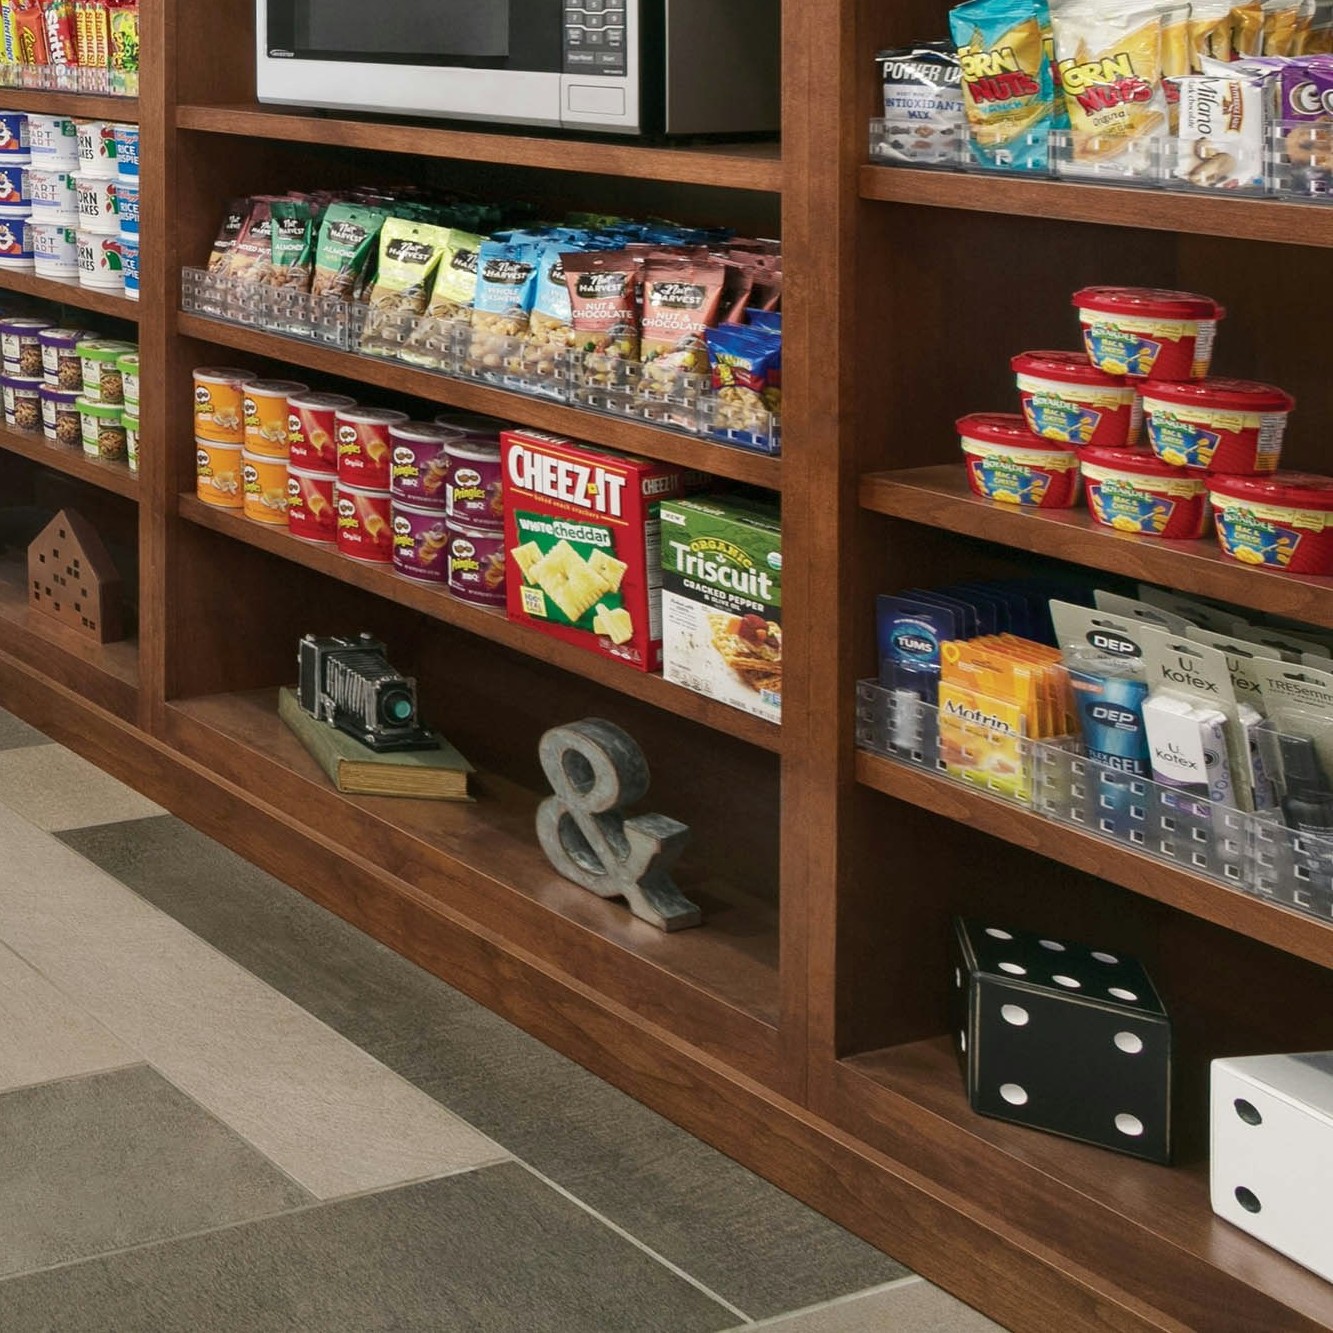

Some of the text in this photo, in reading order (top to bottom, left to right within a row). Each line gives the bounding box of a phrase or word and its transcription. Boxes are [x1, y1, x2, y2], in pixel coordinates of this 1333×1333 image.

[2, 5, 15, 62] Butterfinger
[883, 61, 941, 82] POWER
[968, 70, 1040, 104] NUTS
[885, 97, 965, 112] NTIOXIDANT
[1076, 76, 1152, 117] NUTS
[1196, 77, 1219, 135] Milano
[907, 110, 931, 120] MIX
[32, 131, 53, 139] ART
[32, 139, 52, 147] ART
[33, 184, 58, 193] ART
[33, 192, 57, 201] ART
[34, 237, 56, 245] ART
[331, 229, 368, 243] HARVEST
[34, 245, 55, 253] ART
[485, 269, 527, 280] HARVEST
[579, 282, 624, 293] HARVEST
[585, 302, 617, 311] NUT &
[654, 293, 703, 304] ARVEST
[572, 309, 634, 319] CHOCOLATE
[656, 312, 691, 322] NUT &
[641, 317, 707, 332] CHOCOLATE
[453, 487, 486, 503] Pringles
[553, 522, 609, 543] cheddar
[690, 538, 753, 569] ORGANIC
[669, 540, 773, 601] Triscuit
[683, 578, 765, 612] CRACKED PEPPER
[711, 596, 729, 607] OLIVE
[896, 636, 933, 653] TUMS
[1093, 634, 1134, 653] DEP
[1161, 664, 1220, 694] kotex
[1231, 672, 1263, 695] tex
[1266, 677, 1333, 703] TRESemm
[944, 698, 1010, 732] Motrin
[1092, 706, 1135, 723] DEP
[1109, 756, 1146, 775] GEL
[1155, 747, 1198, 771] kotex
